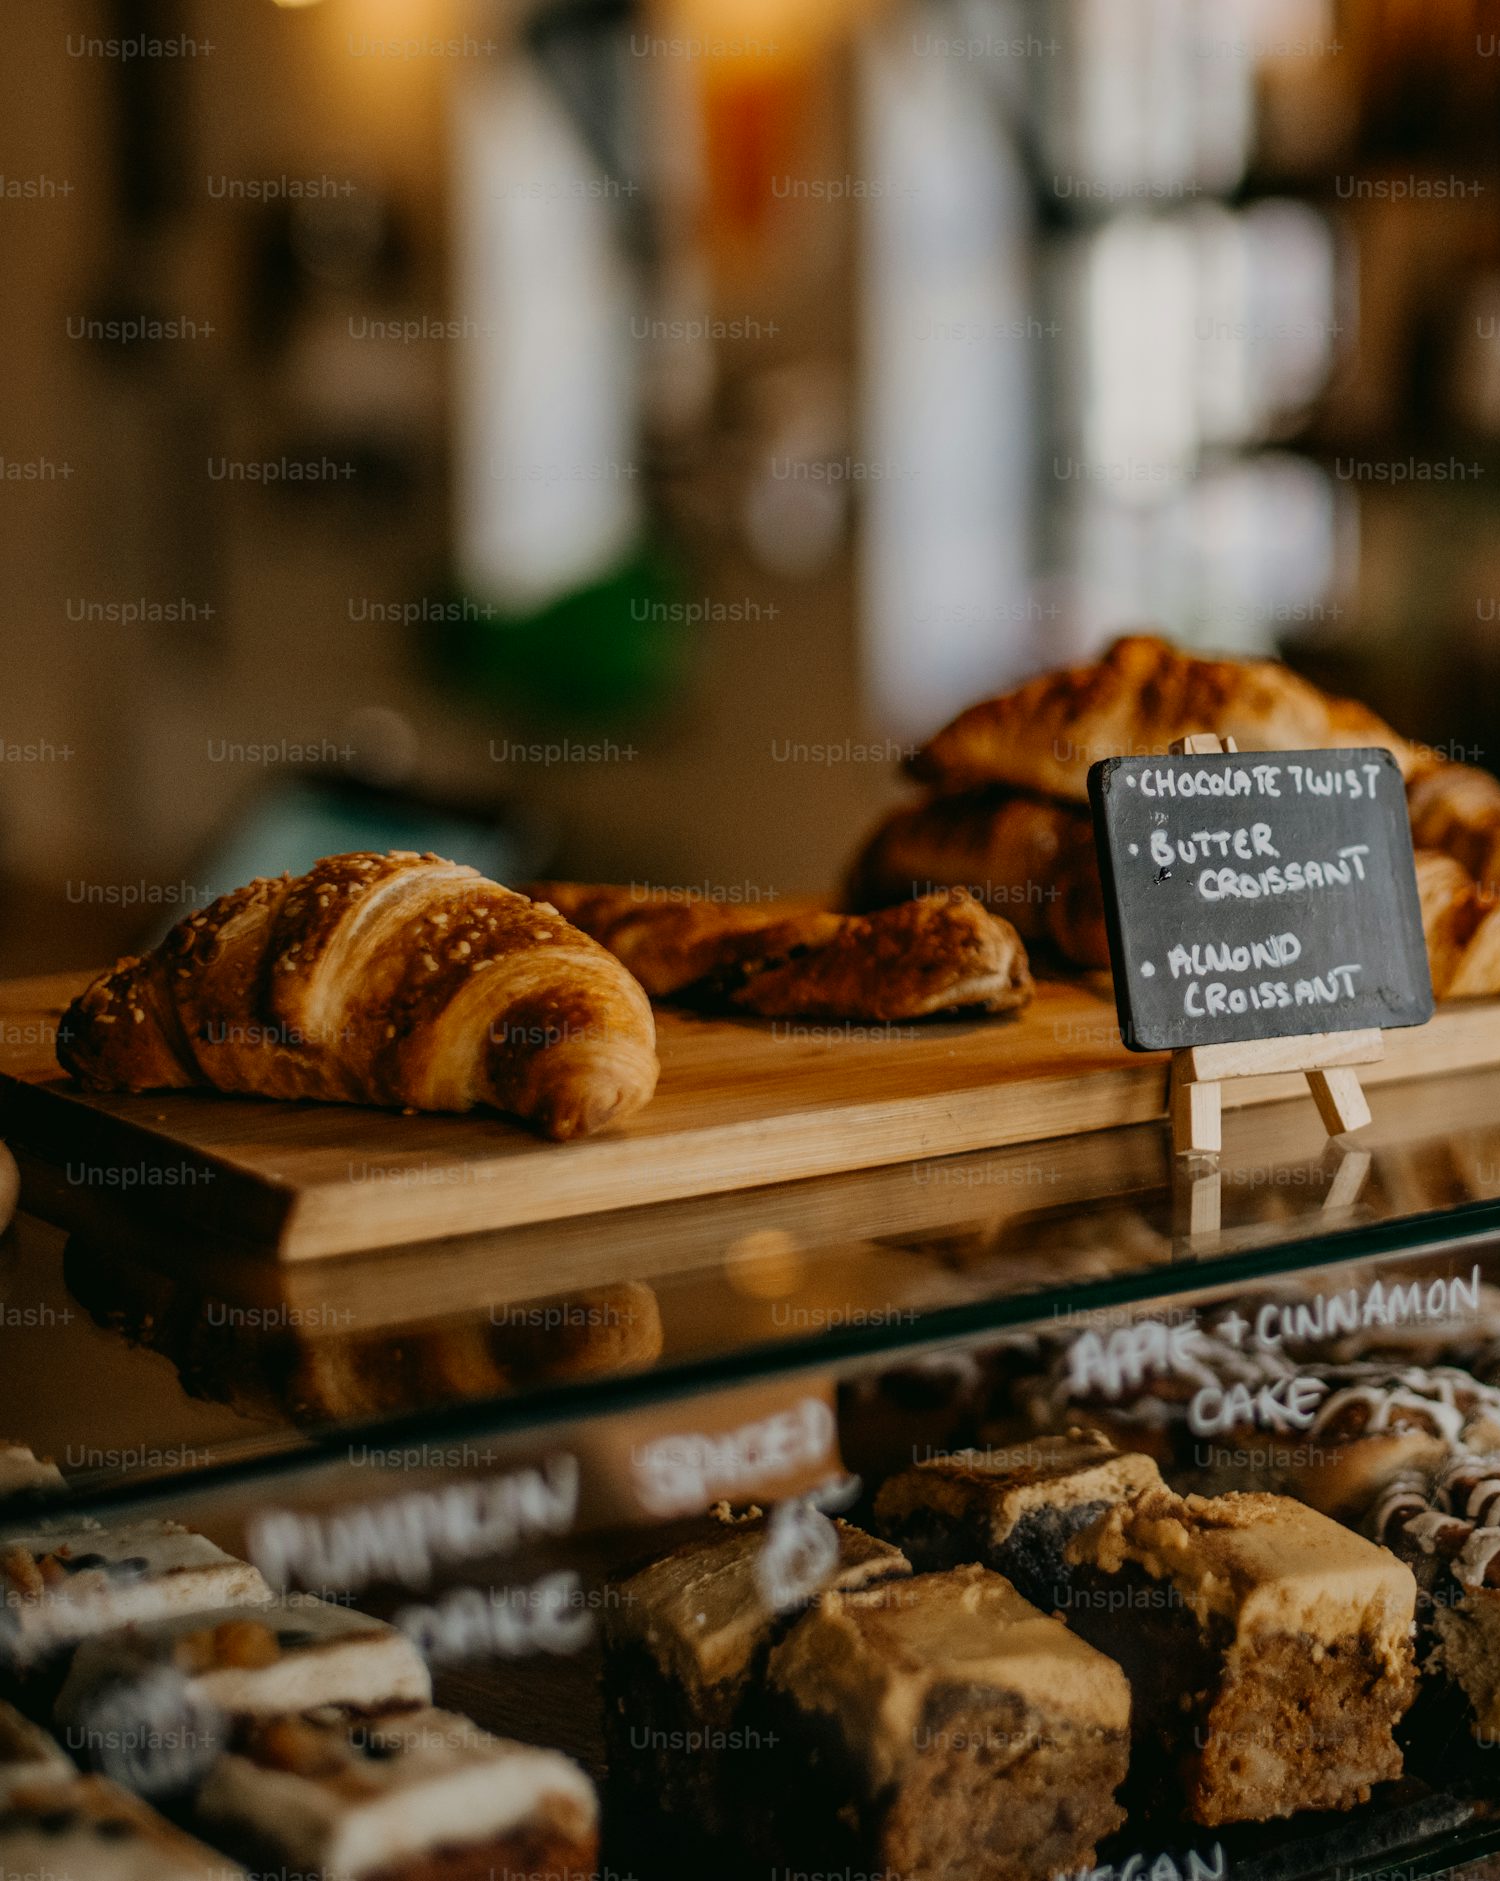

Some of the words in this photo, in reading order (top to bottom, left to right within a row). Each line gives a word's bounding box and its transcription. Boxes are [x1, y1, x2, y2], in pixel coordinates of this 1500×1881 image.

[1140, 764, 1281, 798] CHOCOLATE
[1288, 765, 1380, 799] TWIST
[1150, 823, 1280, 866] BUTTER
[1199, 845, 1369, 900] CROISSANT
[1168, 932, 1302, 978] ALMOND
[1184, 964, 1362, 1018] CROISSANT
[1256, 1263, 1481, 1347] CINNAMON
[1188, 1375, 1328, 1437] CAKE
